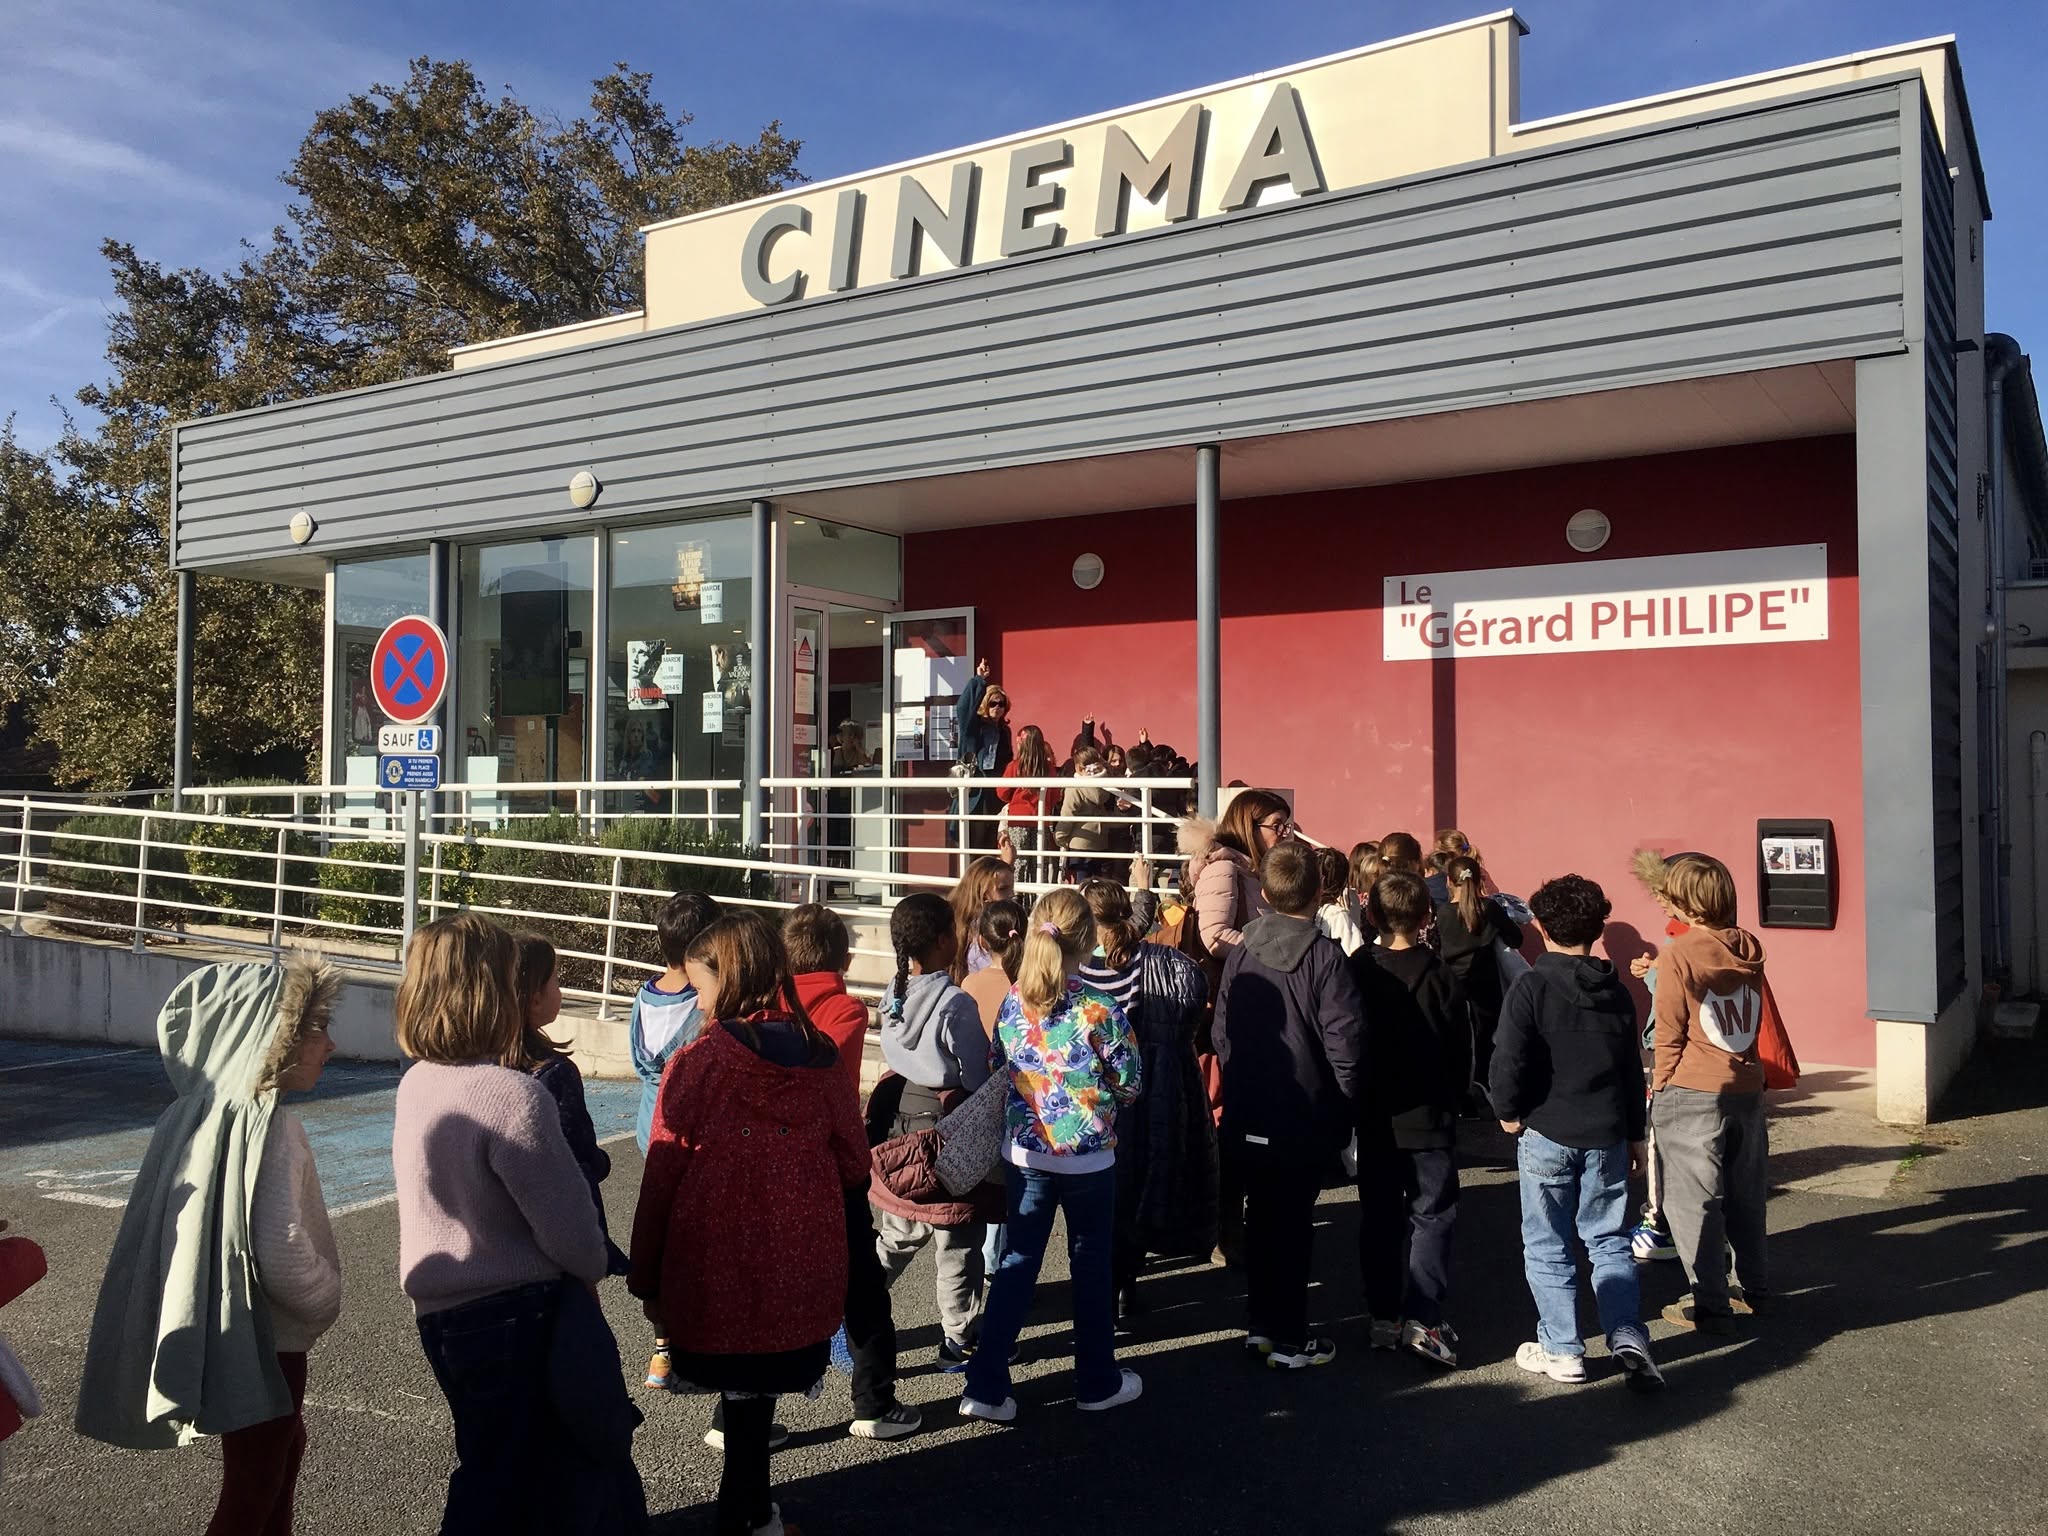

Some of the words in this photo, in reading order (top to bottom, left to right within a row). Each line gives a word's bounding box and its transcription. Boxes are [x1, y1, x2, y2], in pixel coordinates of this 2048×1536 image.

[741, 82, 1325, 305] CINEMA
[1401, 581, 1432, 605] Le
[1401, 602, 1573, 648] "Gérard
[1591, 587, 1810, 640] PHILIPE"
[383, 733, 414, 746] SAUF
